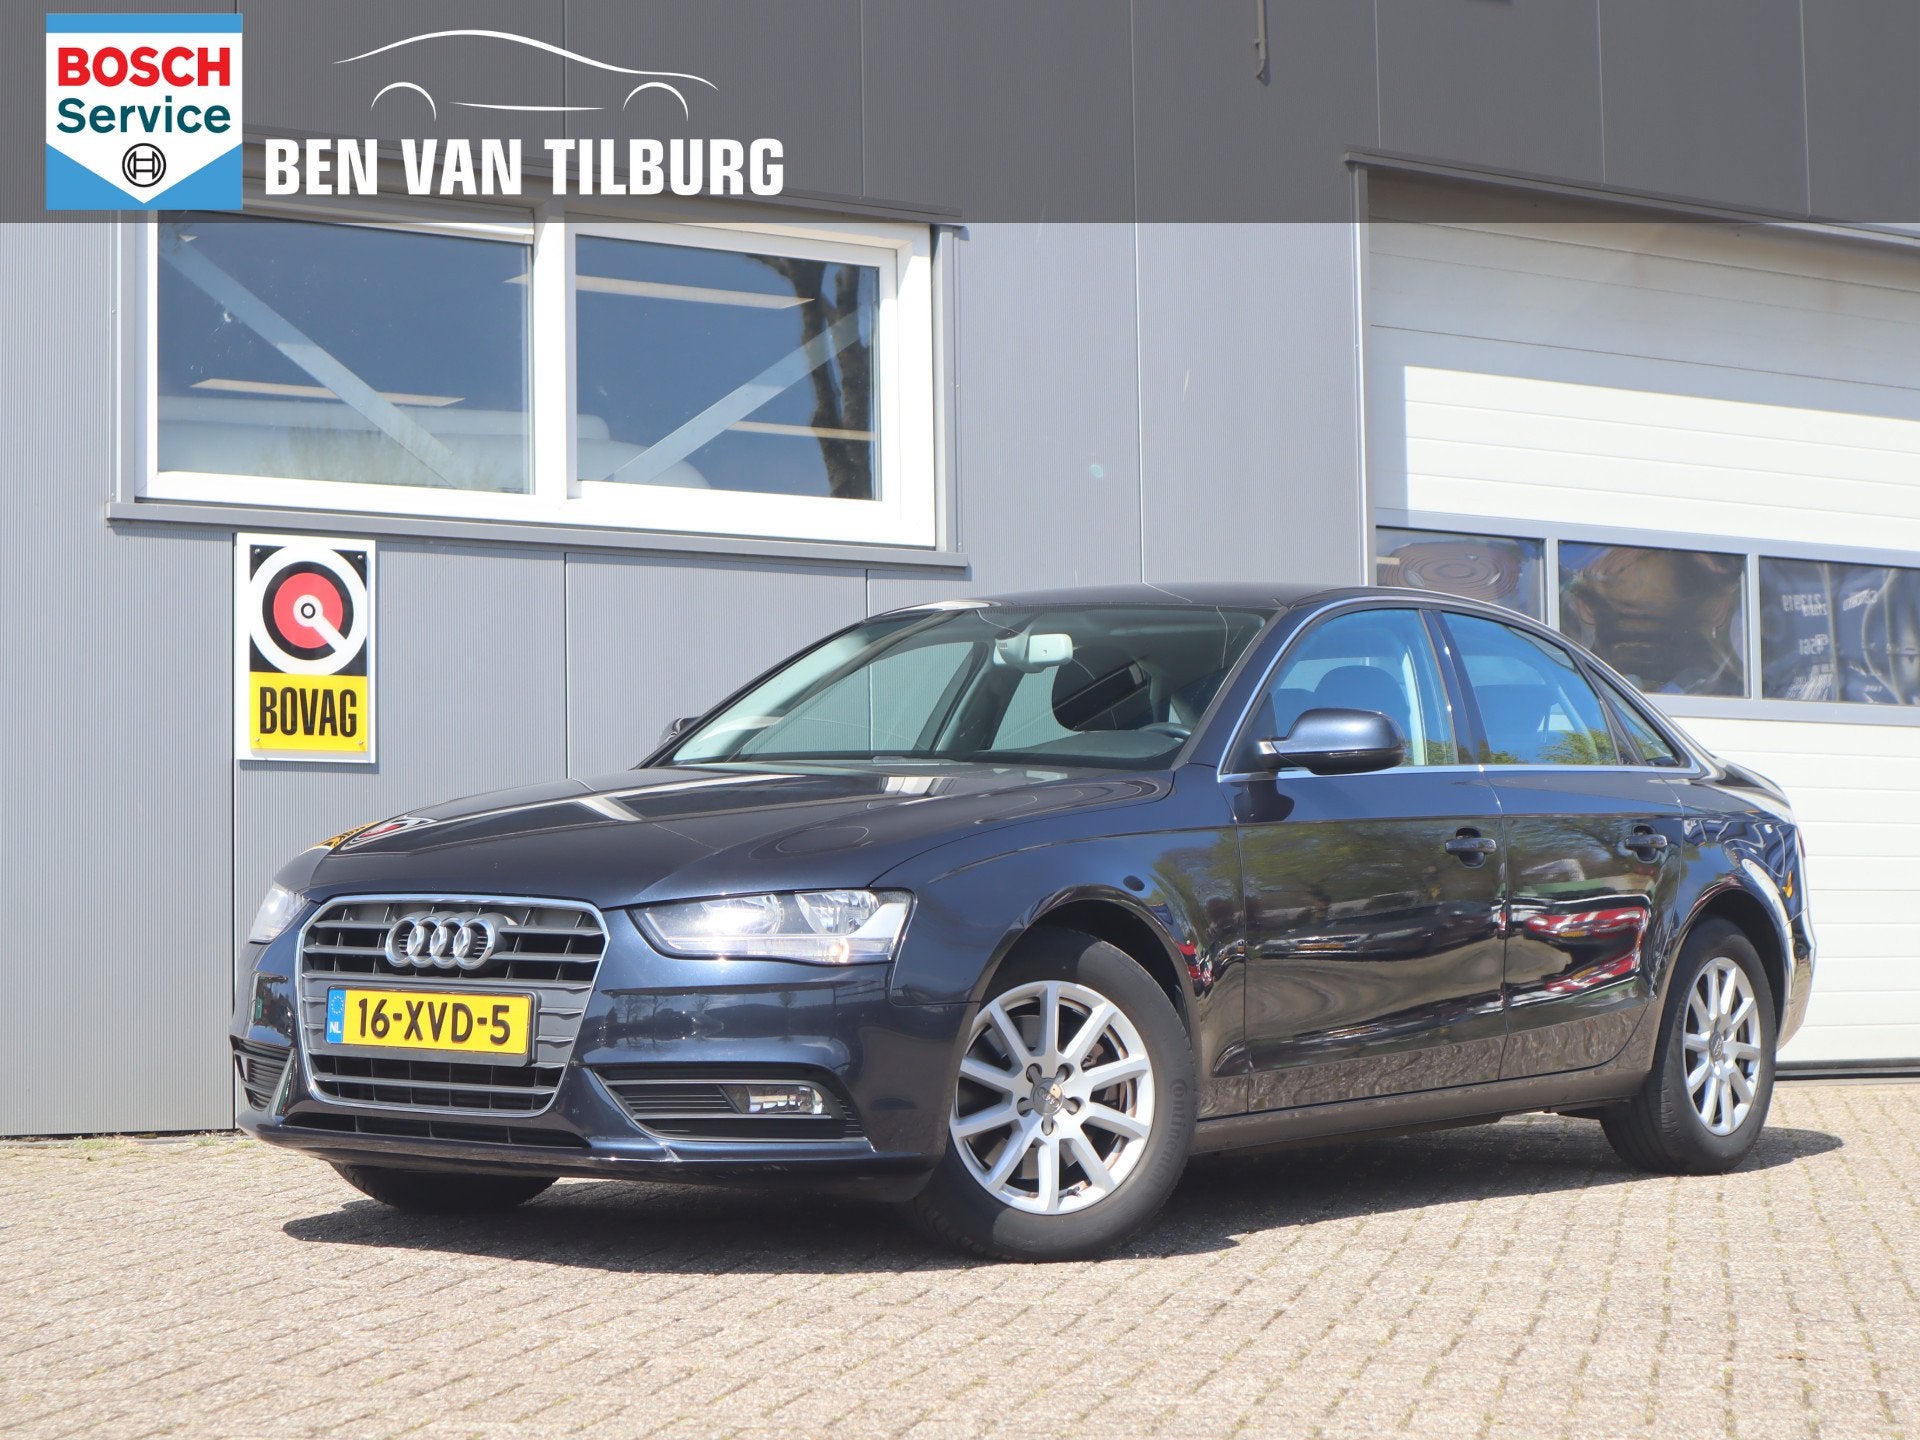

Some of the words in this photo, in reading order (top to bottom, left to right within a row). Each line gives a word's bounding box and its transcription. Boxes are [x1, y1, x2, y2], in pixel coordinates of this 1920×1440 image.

[259, 686, 357, 738] BOVAG
[329, 1021, 341, 1034] NL
[358, 998, 511, 1045] 16-XVD-5
